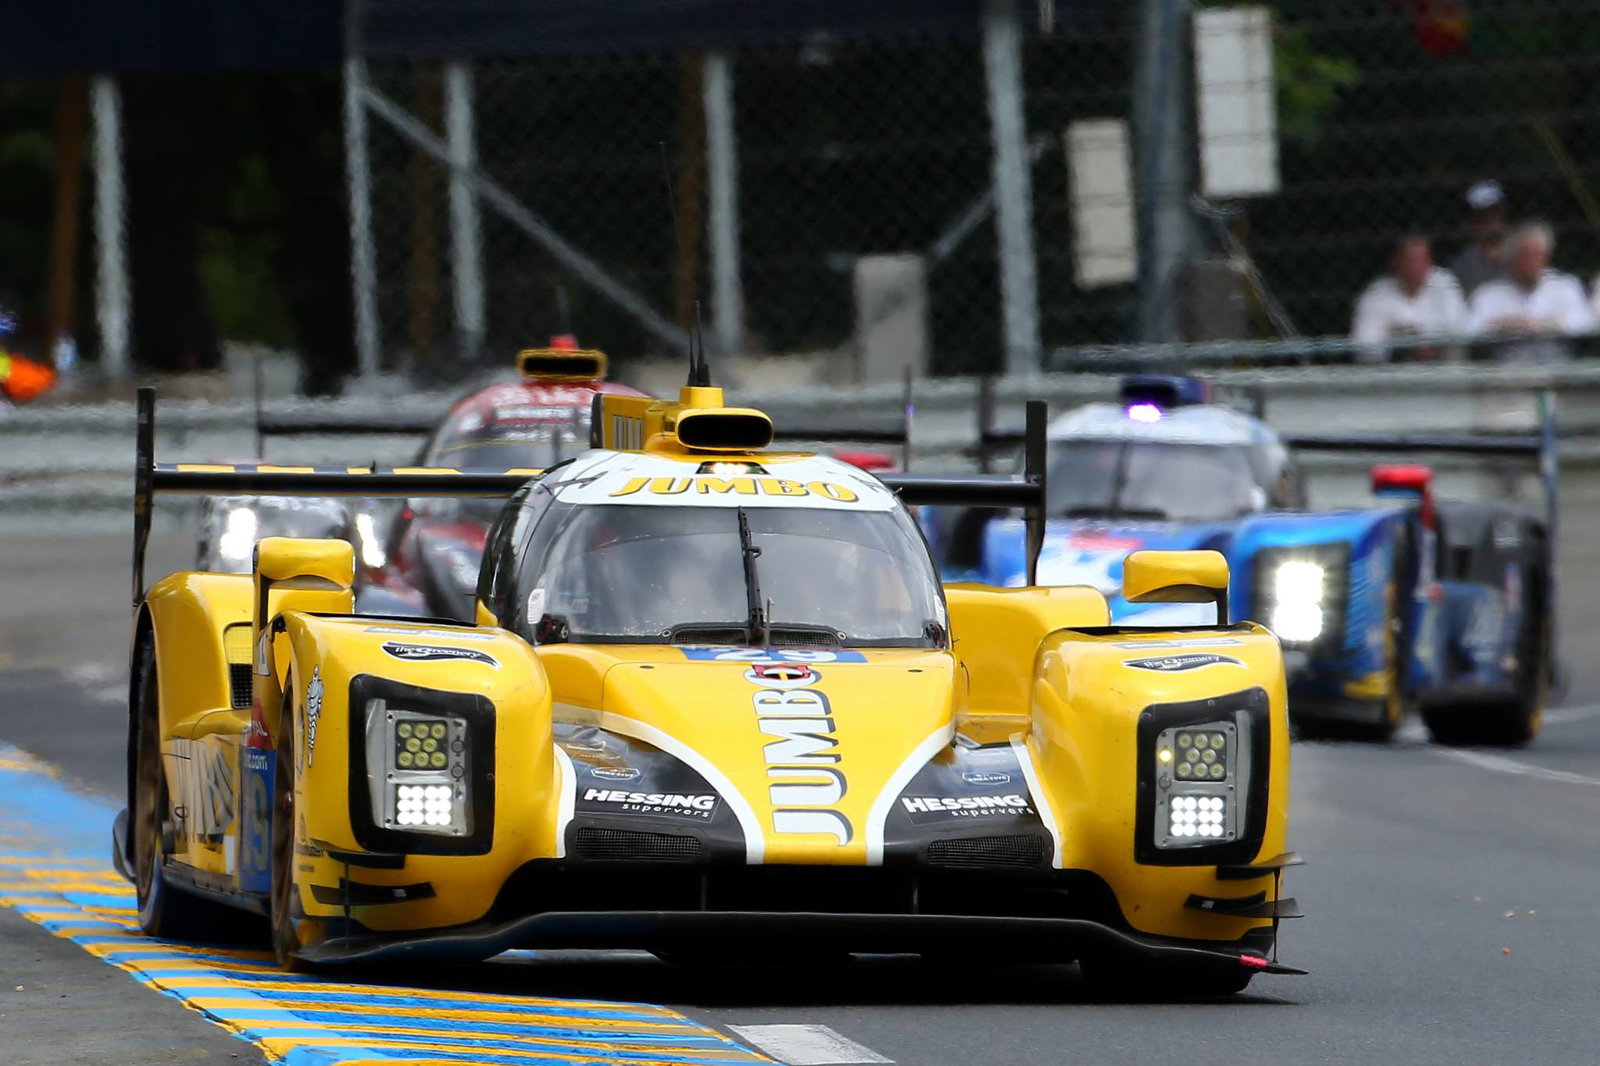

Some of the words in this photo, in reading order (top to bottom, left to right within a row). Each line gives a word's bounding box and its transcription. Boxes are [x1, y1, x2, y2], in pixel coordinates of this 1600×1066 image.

[608, 476, 859, 503] JUMBO
[714, 648, 838, 663] 29
[743, 664, 854, 847] JUMBO
[584, 788, 716, 811] HESSING
[901, 794, 1028, 814] HESSING
[621, 803, 711, 819] supervers
[951, 806, 1035, 818] supervers
